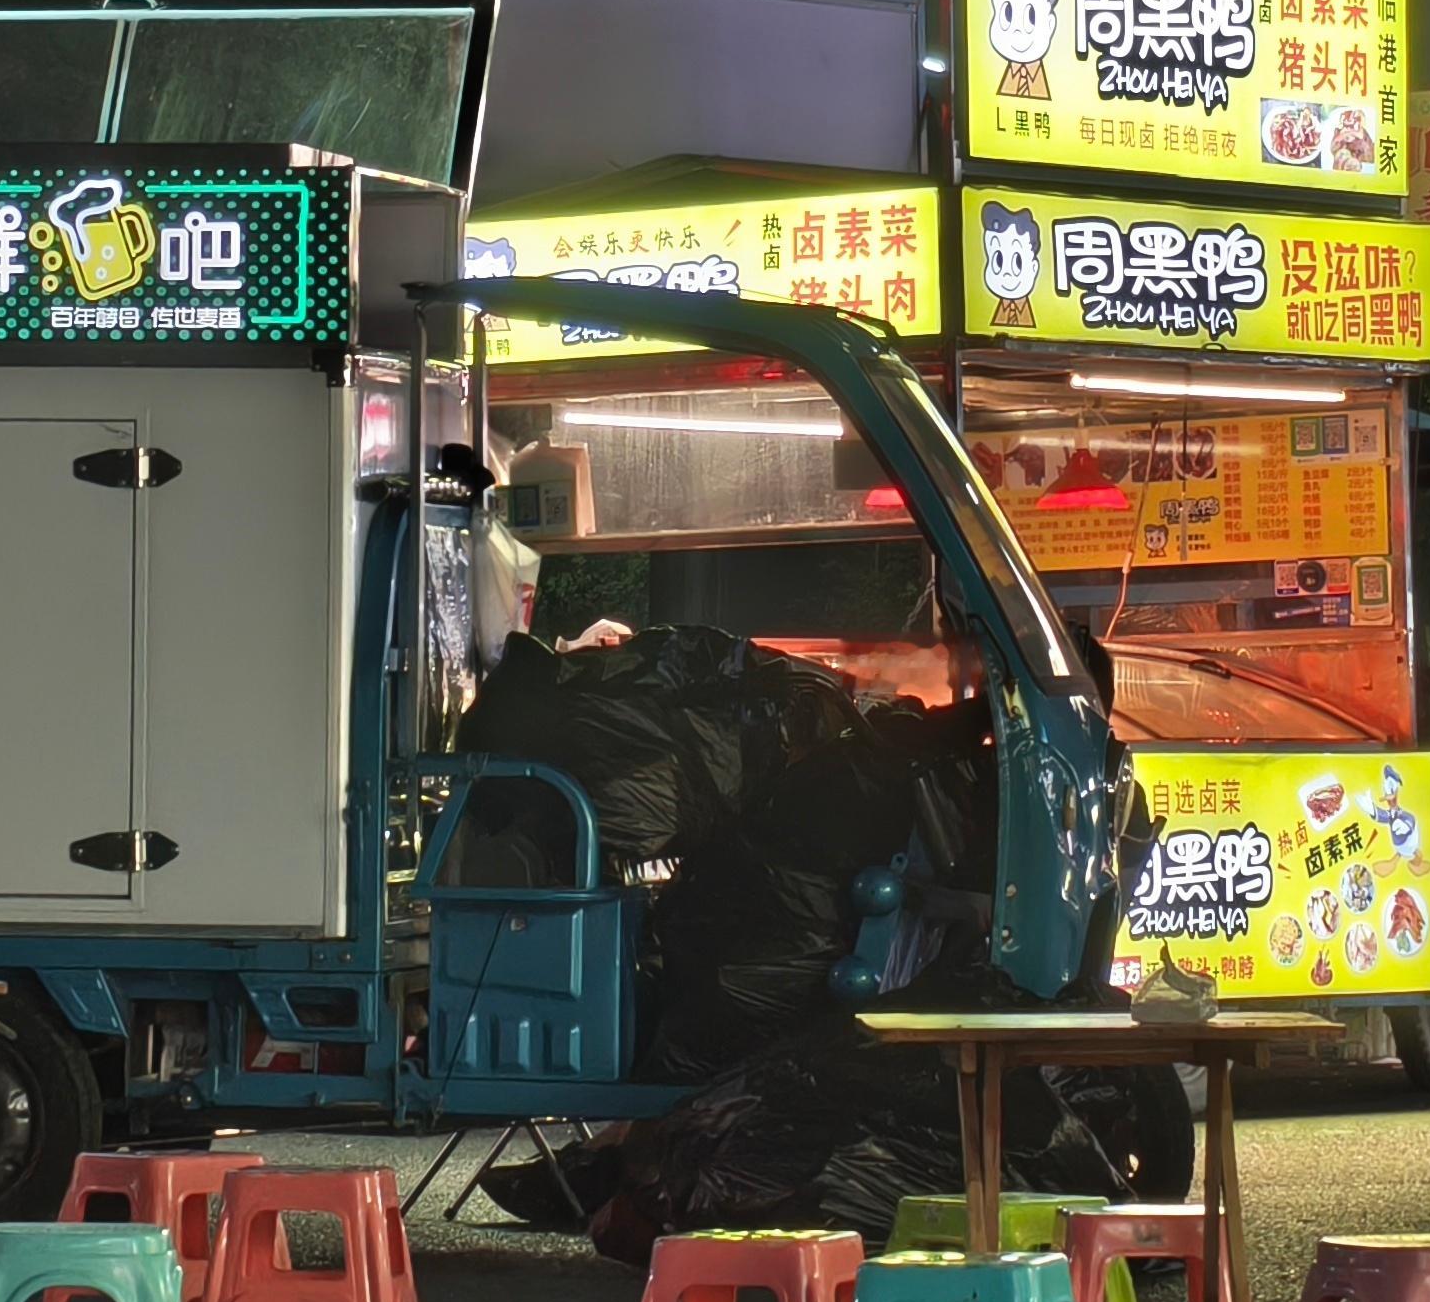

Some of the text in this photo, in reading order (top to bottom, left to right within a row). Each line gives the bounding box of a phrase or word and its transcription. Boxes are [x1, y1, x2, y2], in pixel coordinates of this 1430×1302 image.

[1098, 60, 1228, 108] ZHOU HEI YA
[1278, 36, 1368, 97] 猪头肉
[1079, 115, 1238, 159] 每日现卤 拒绝隔夜
[159, 210, 243, 291] 吧
[761, 213, 783, 272] 热卤
[791, 204, 918, 263] 卤素菜
[1053, 220, 1265, 304] 周黑鸭
[50, 306, 241, 329] 百年酵母 传世麦香
[1083, 297, 1236, 336] ZHOU HEI YA
[1286, 289, 1423, 348] 就吃周黑鸭
[1152, 780, 1241, 817] 自选卤菜
[1276, 820, 1309, 859] 热卤
[1304, 822, 1365, 879] 卤素菜
[1129, 908, 1184, 935] ZHOU
[1218, 907, 1247, 937] YA
